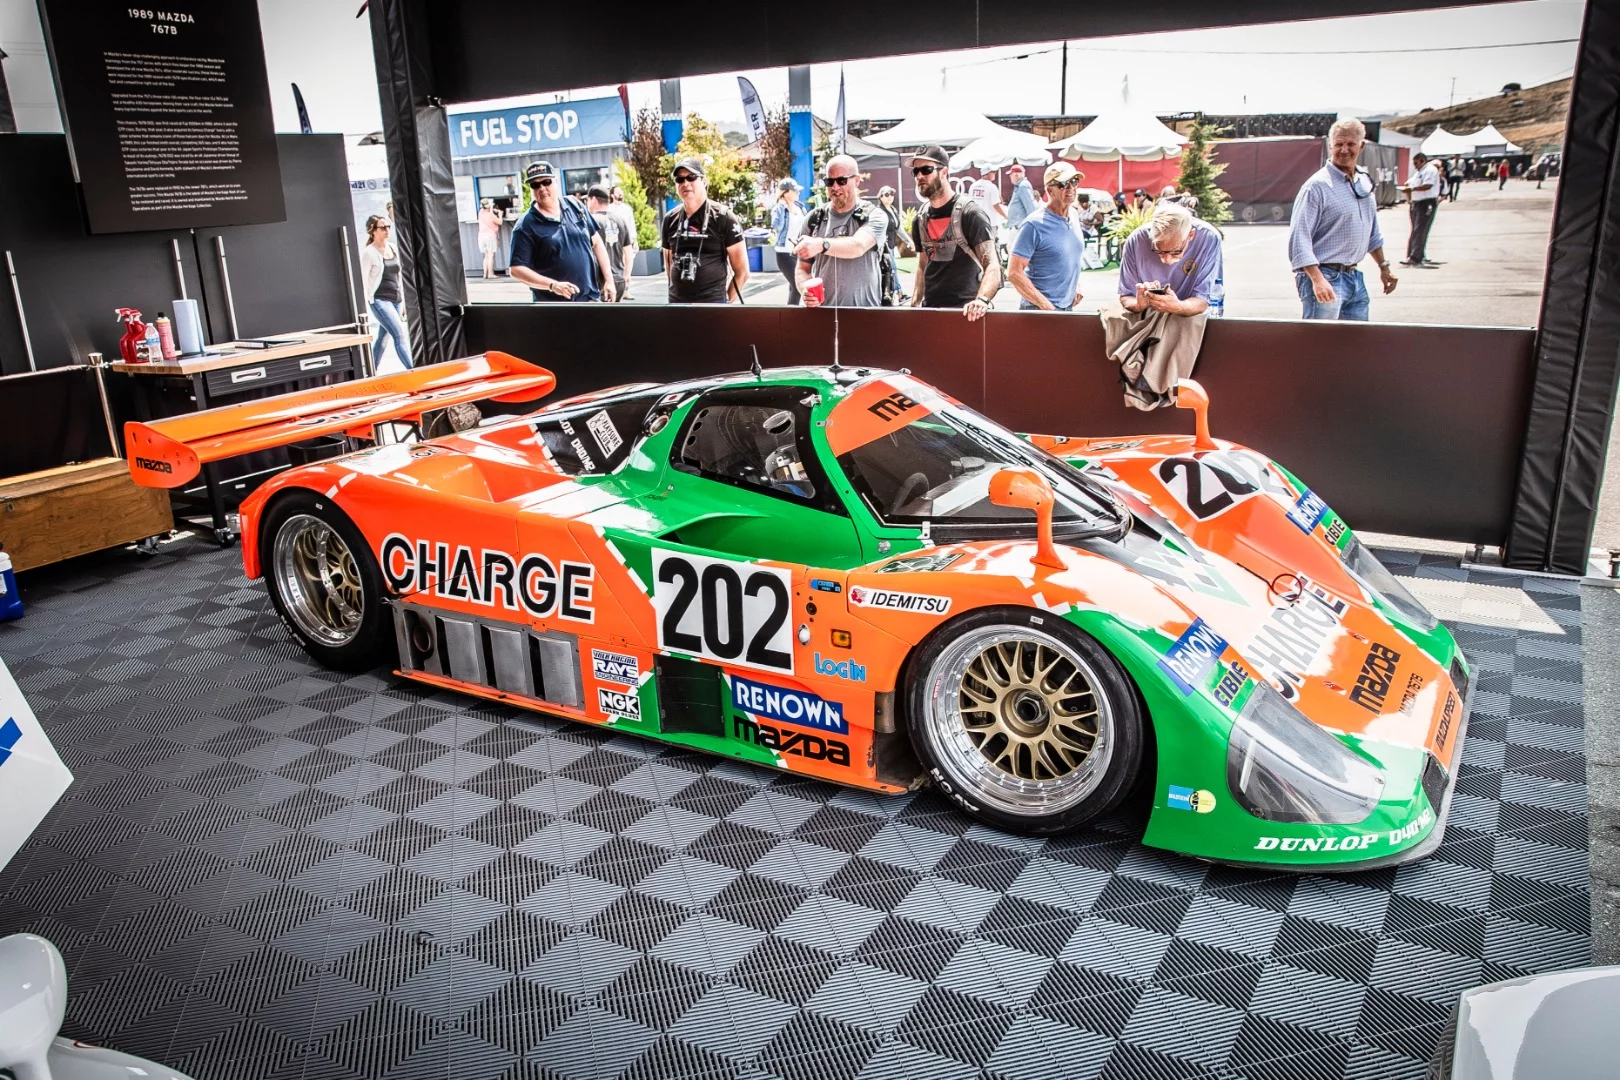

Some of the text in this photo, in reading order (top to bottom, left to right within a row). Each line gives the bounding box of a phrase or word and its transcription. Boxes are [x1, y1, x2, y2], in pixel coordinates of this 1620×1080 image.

[128, 8, 195, 24] 1989 MAZDA
[151, 24, 178, 35] 767B
[460, 109, 579, 148] FUEL STOP
[381, 535, 594, 623] CHARGE
[870, 592, 949, 613] IDEMITSU
[658, 556, 792, 671] 202
[594, 659, 638, 679] RAYS
[610, 654, 637, 665] RACING
[595, 671, 639, 686] ENGINEERING
[1213, 660, 1249, 707] CIBIE
[600, 690, 639, 715] NGK
[736, 681, 841, 729] RENOWN
[1253, 833, 1379, 852] DUNLOP
